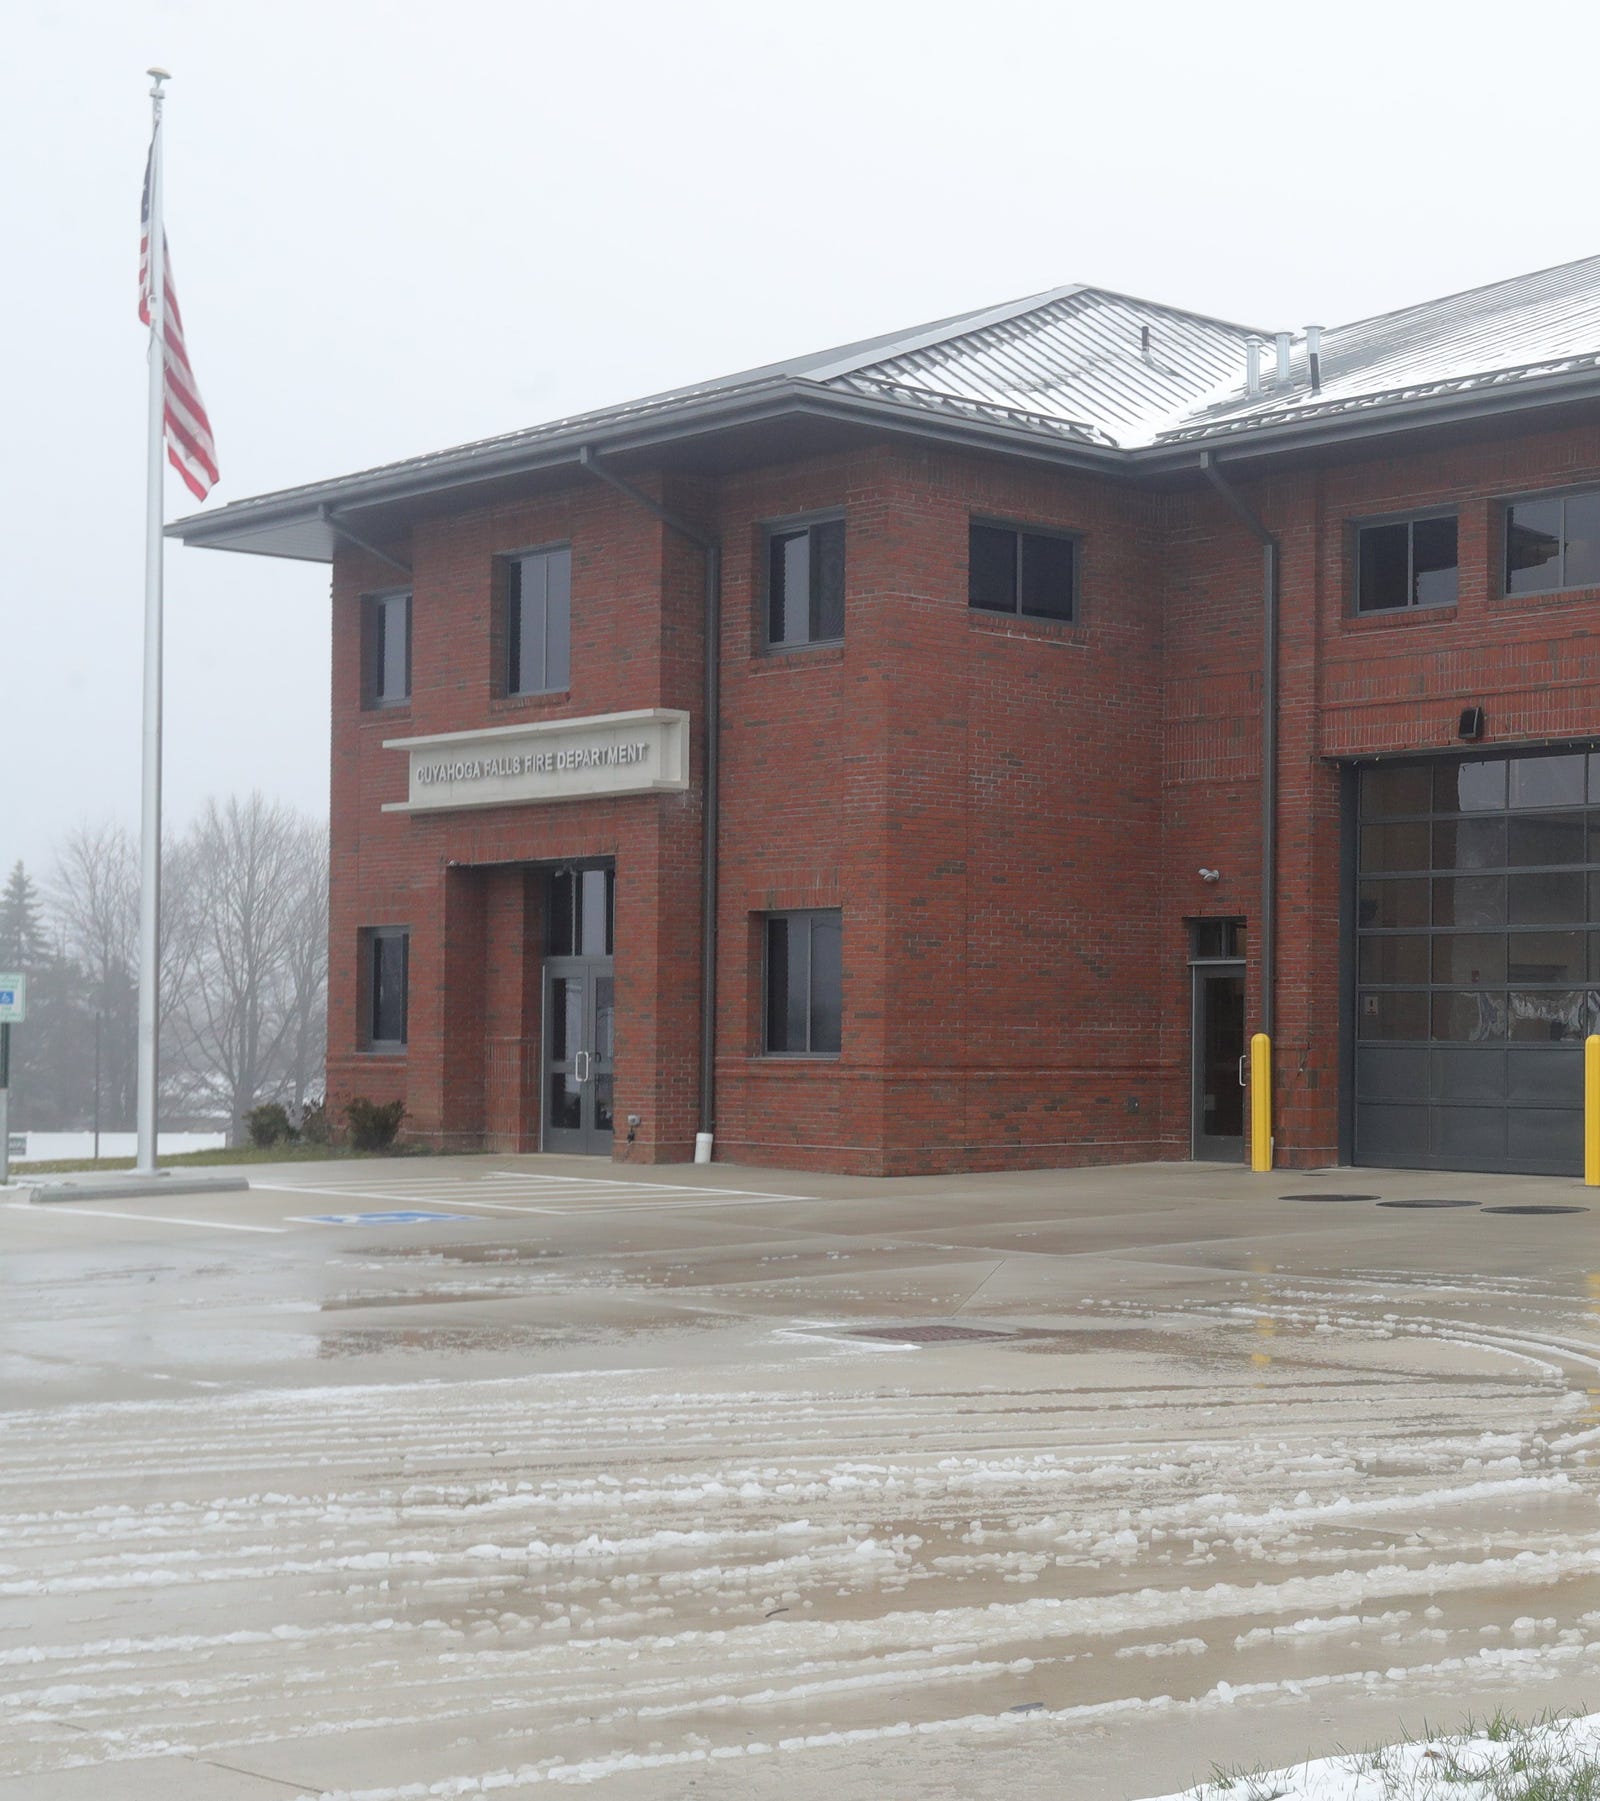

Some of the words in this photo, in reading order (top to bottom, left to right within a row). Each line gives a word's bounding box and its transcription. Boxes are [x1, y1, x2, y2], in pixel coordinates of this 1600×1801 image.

[416, 761, 481, 784] CUYAHOGA
[484, 755, 521, 777] FALLS
[524, 752, 553, 773] FIRE
[557, 742, 646, 770] DEPARTMENT
